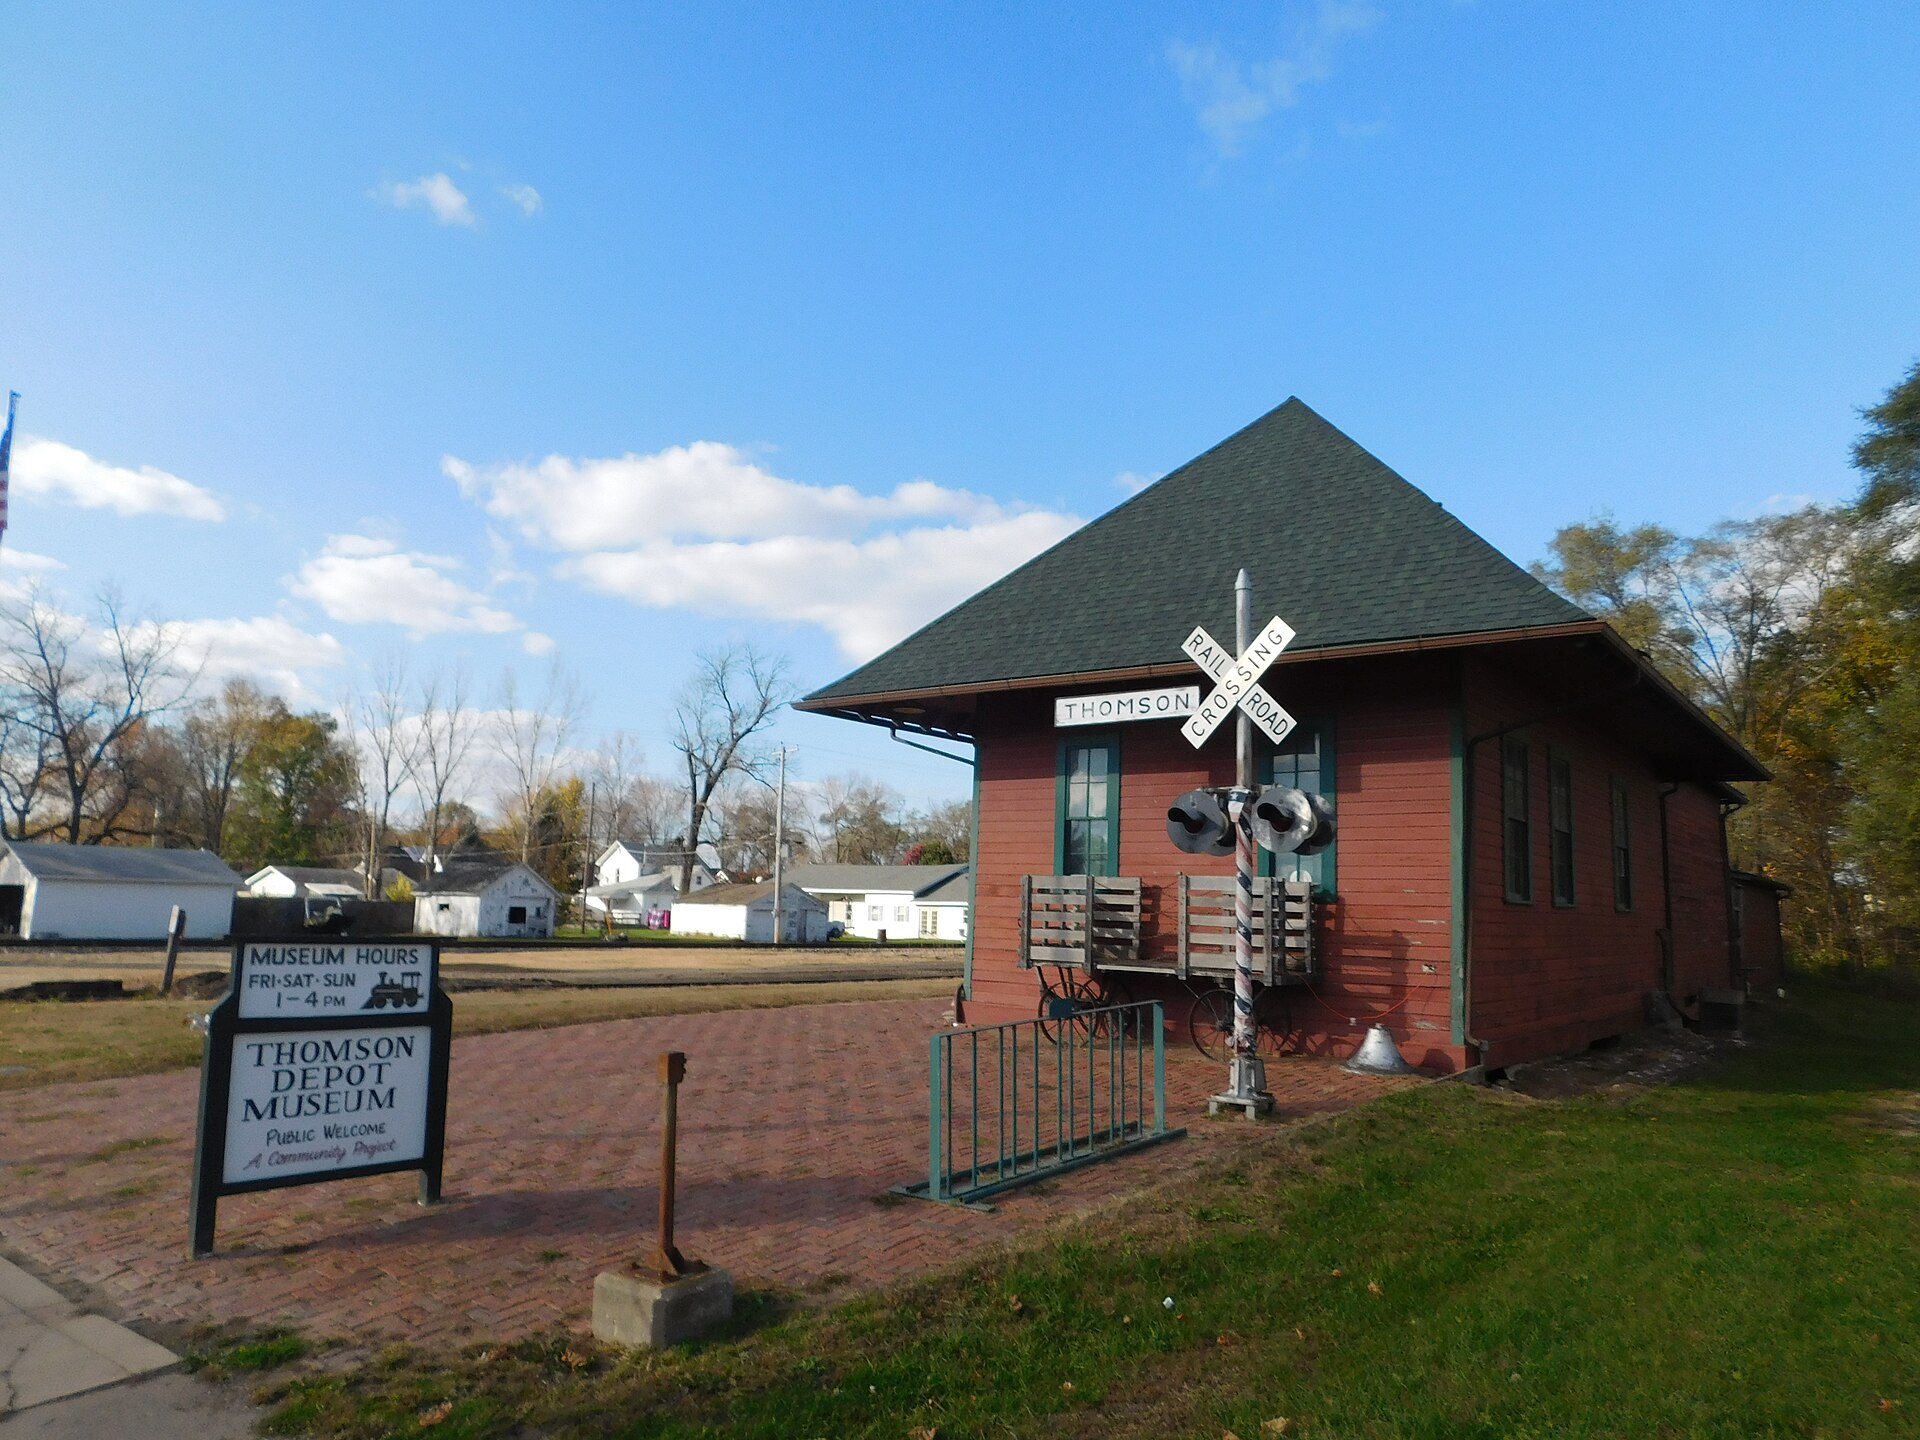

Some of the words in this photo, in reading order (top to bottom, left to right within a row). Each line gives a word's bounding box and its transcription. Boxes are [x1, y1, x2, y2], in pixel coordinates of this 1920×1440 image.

[1188, 634, 1226, 677] RAIL
[1246, 692, 1288, 736] ROAD
[1191, 630, 1283, 737] CROSSING
[1065, 693, 1189, 719] THOMSON
[250, 947, 345, 966] MUSEUM
[356, 948, 419, 965] HOURS
[323, 995, 346, 1007] PM
[246, 1035, 416, 1068] THOMSON
[271, 1062, 392, 1093] DEPOT
[241, 1086, 397, 1122] MUSEUM
[266, 1128, 316, 1147] PUBLIC
[323, 1122, 387, 1140] WELCOME
[243, 1152, 263, 1171] A
[267, 1145, 347, 1167] Community
[353, 1139, 397, 1158] Project
